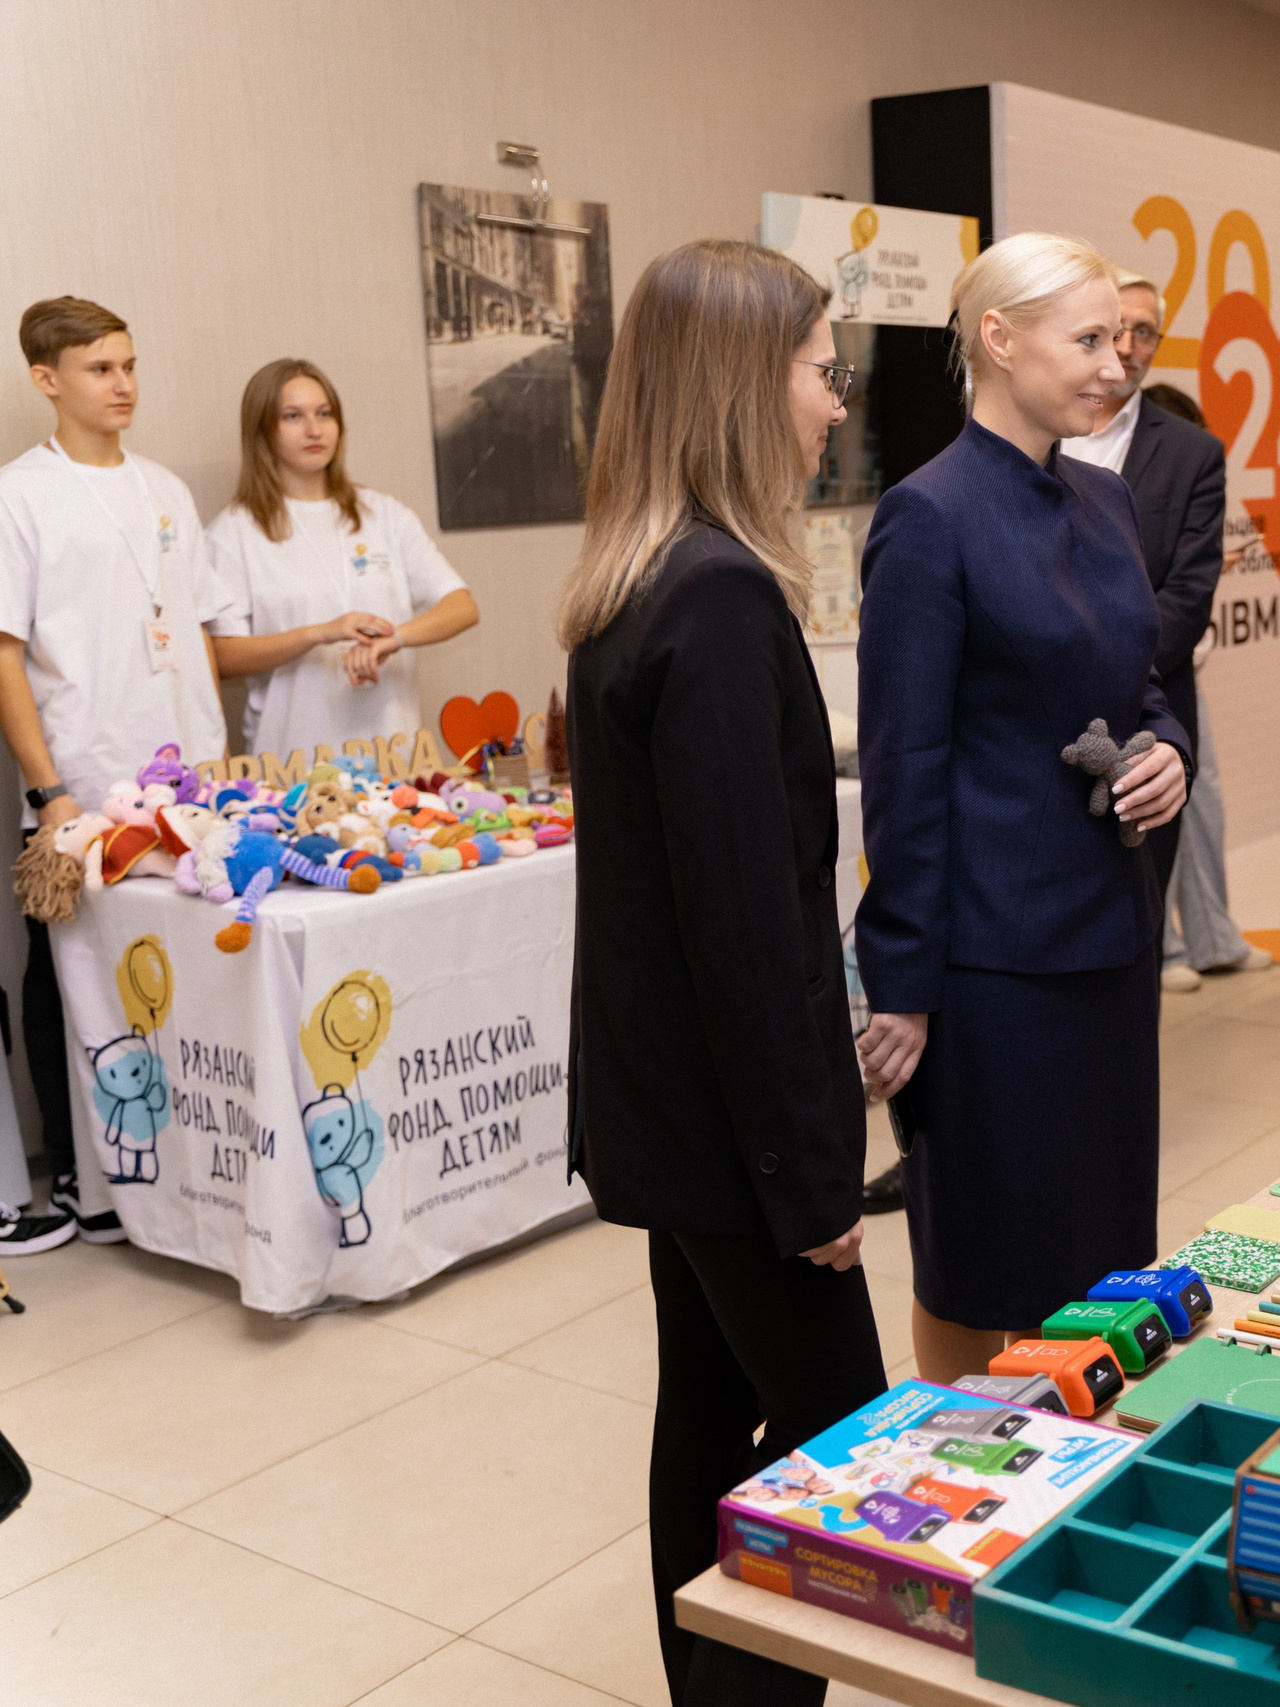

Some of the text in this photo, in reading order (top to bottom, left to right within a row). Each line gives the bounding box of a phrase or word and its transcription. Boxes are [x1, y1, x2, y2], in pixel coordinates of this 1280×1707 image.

[179, 1038, 257, 1098] РЯЗАНС
[399, 1014, 536, 1097] РЯЗАНСКИЙ
[225, 1098, 276, 1160] ПОЩИ
[387, 1060, 564, 1152] ФОНД ПОМОЩИ
[437, 1115, 522, 1182] ДЕТЯМ
[794, 1545, 879, 1583] СОРТИРОВКА
[809, 1566, 863, 1592] МУСОРА
